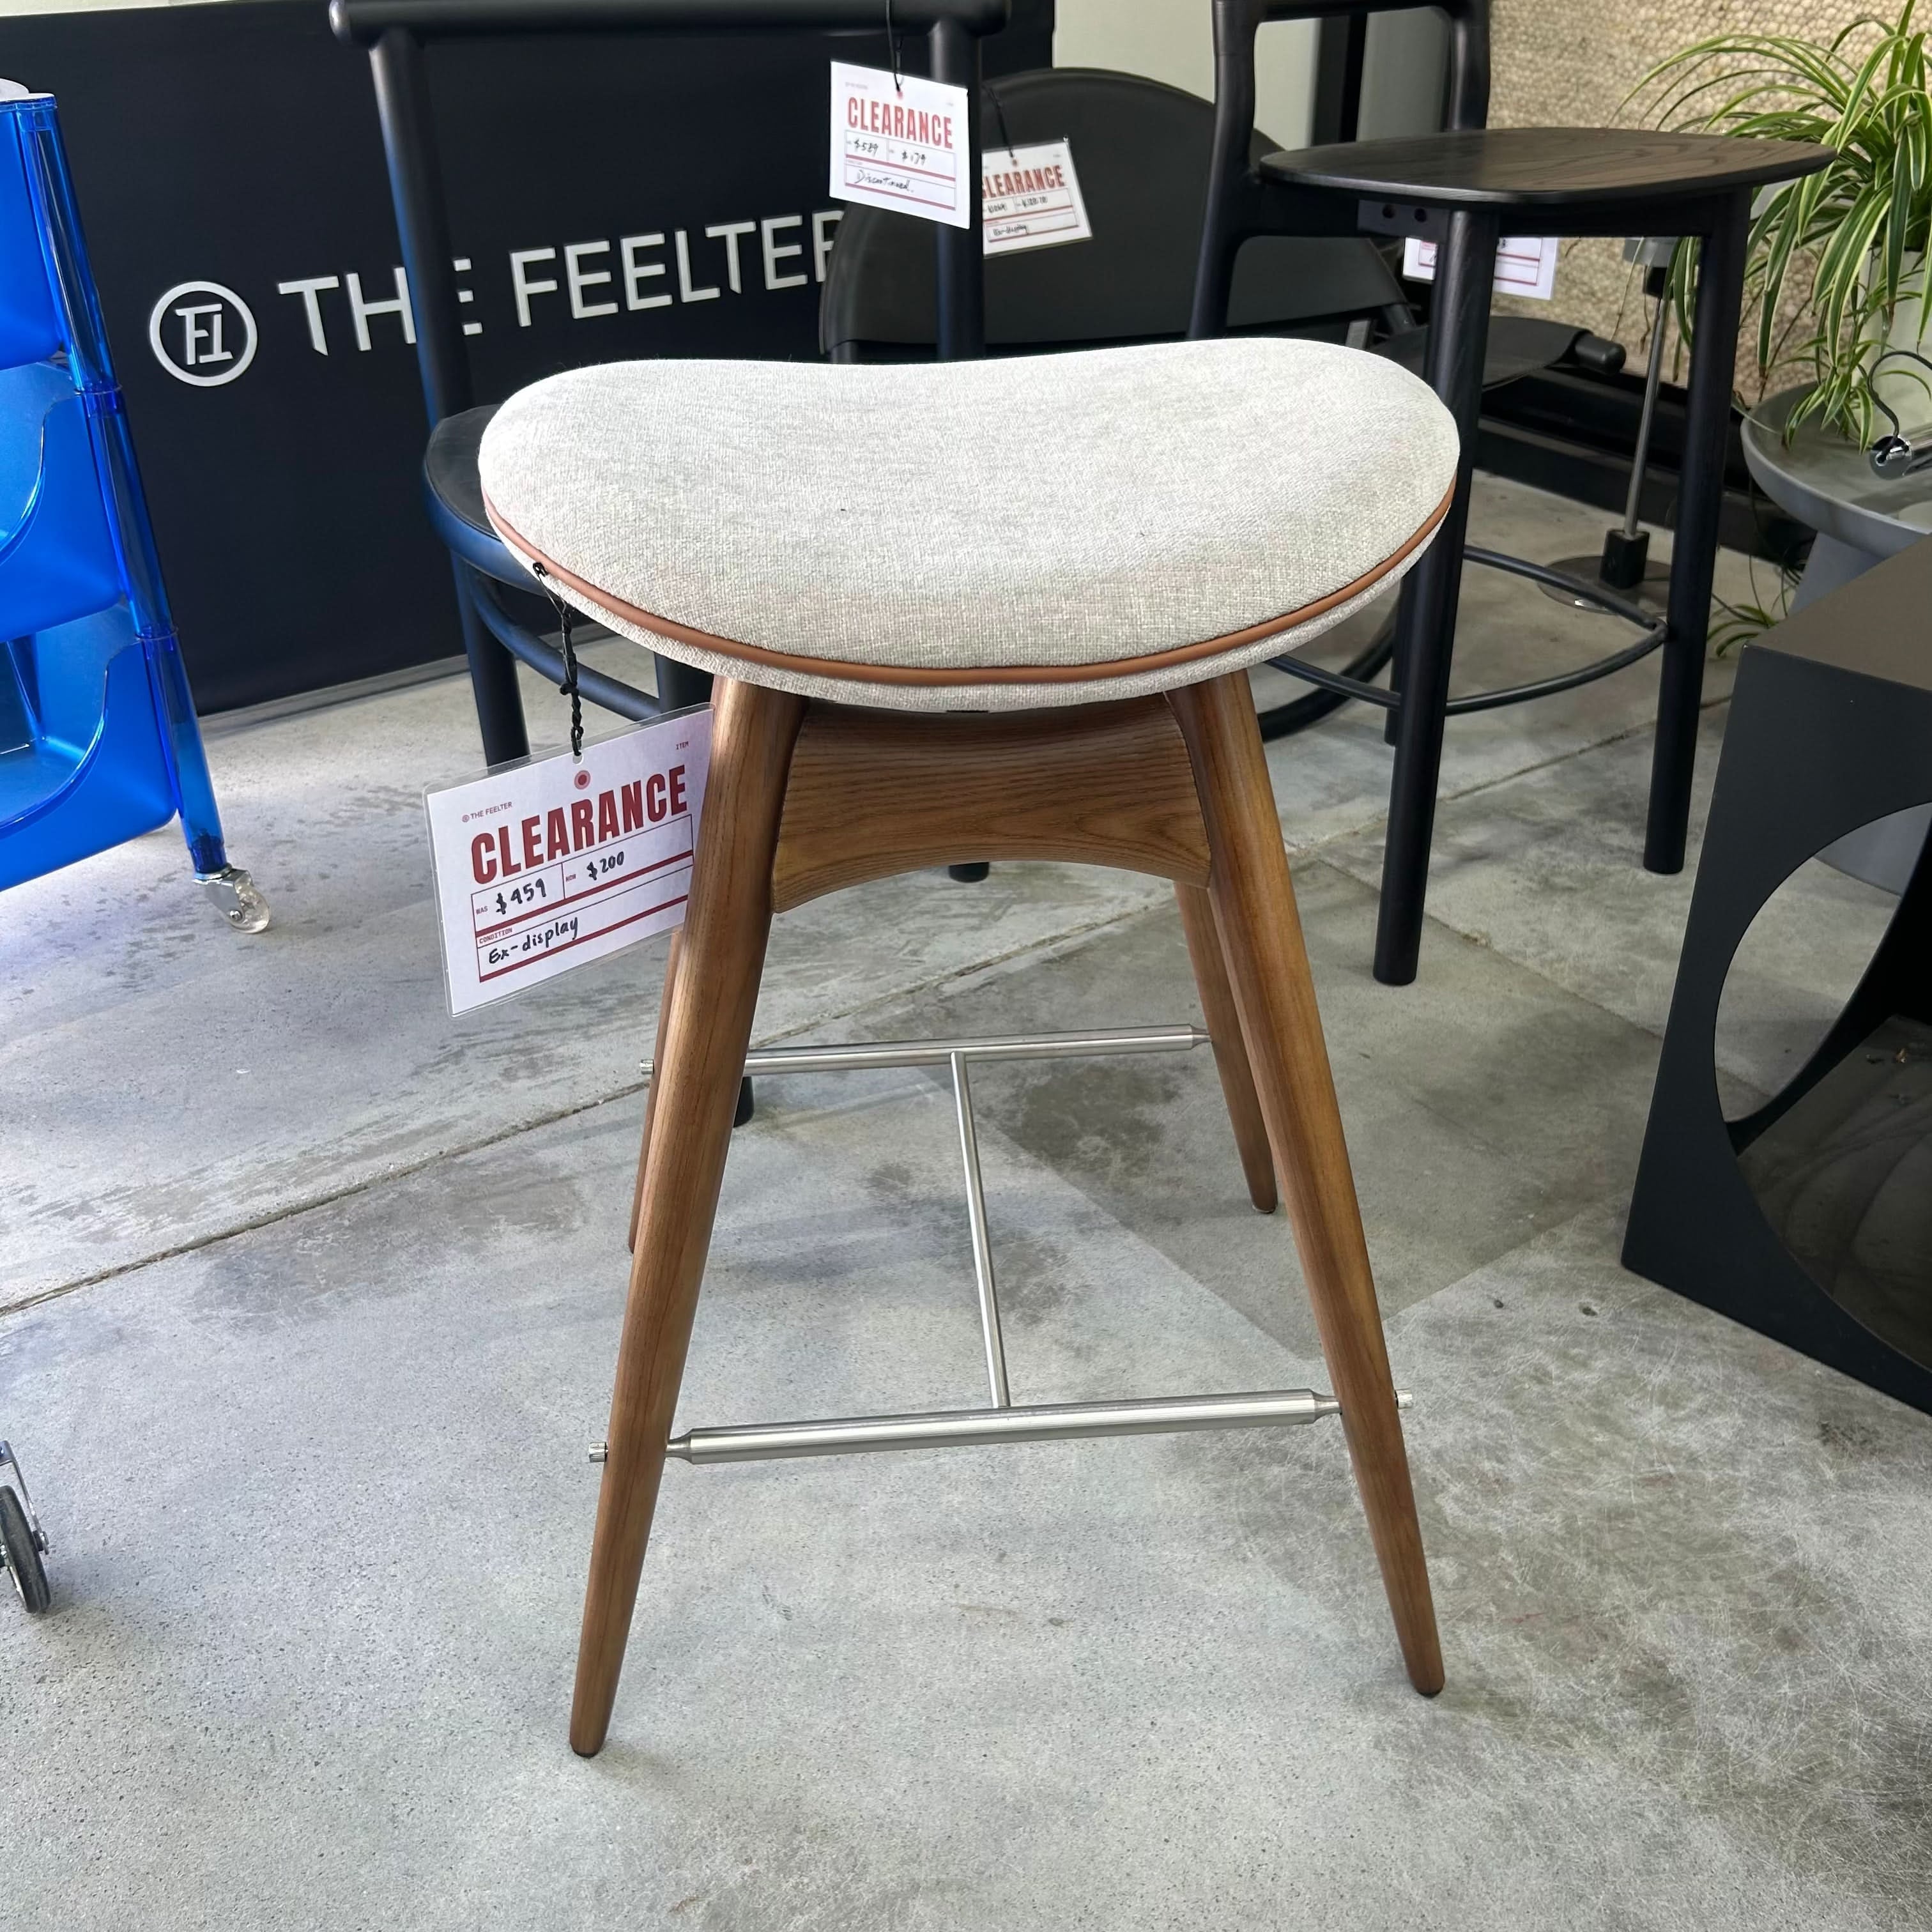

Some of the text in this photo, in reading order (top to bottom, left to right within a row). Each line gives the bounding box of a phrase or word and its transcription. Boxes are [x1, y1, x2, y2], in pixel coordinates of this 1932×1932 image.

[848, 97, 953, 149] CLEARANCE
[278, 258, 482, 356] TH
[676, 741, 689, 750] ITEM
[470, 802, 513, 820] THE FEELTER
[471, 765, 687, 884] CLEARANCE
[586, 851, 624, 880] $200
[476, 907, 488, 915] WAS
[479, 928, 513, 944] CONDITION
[489, 917, 578, 964] Ex-display
